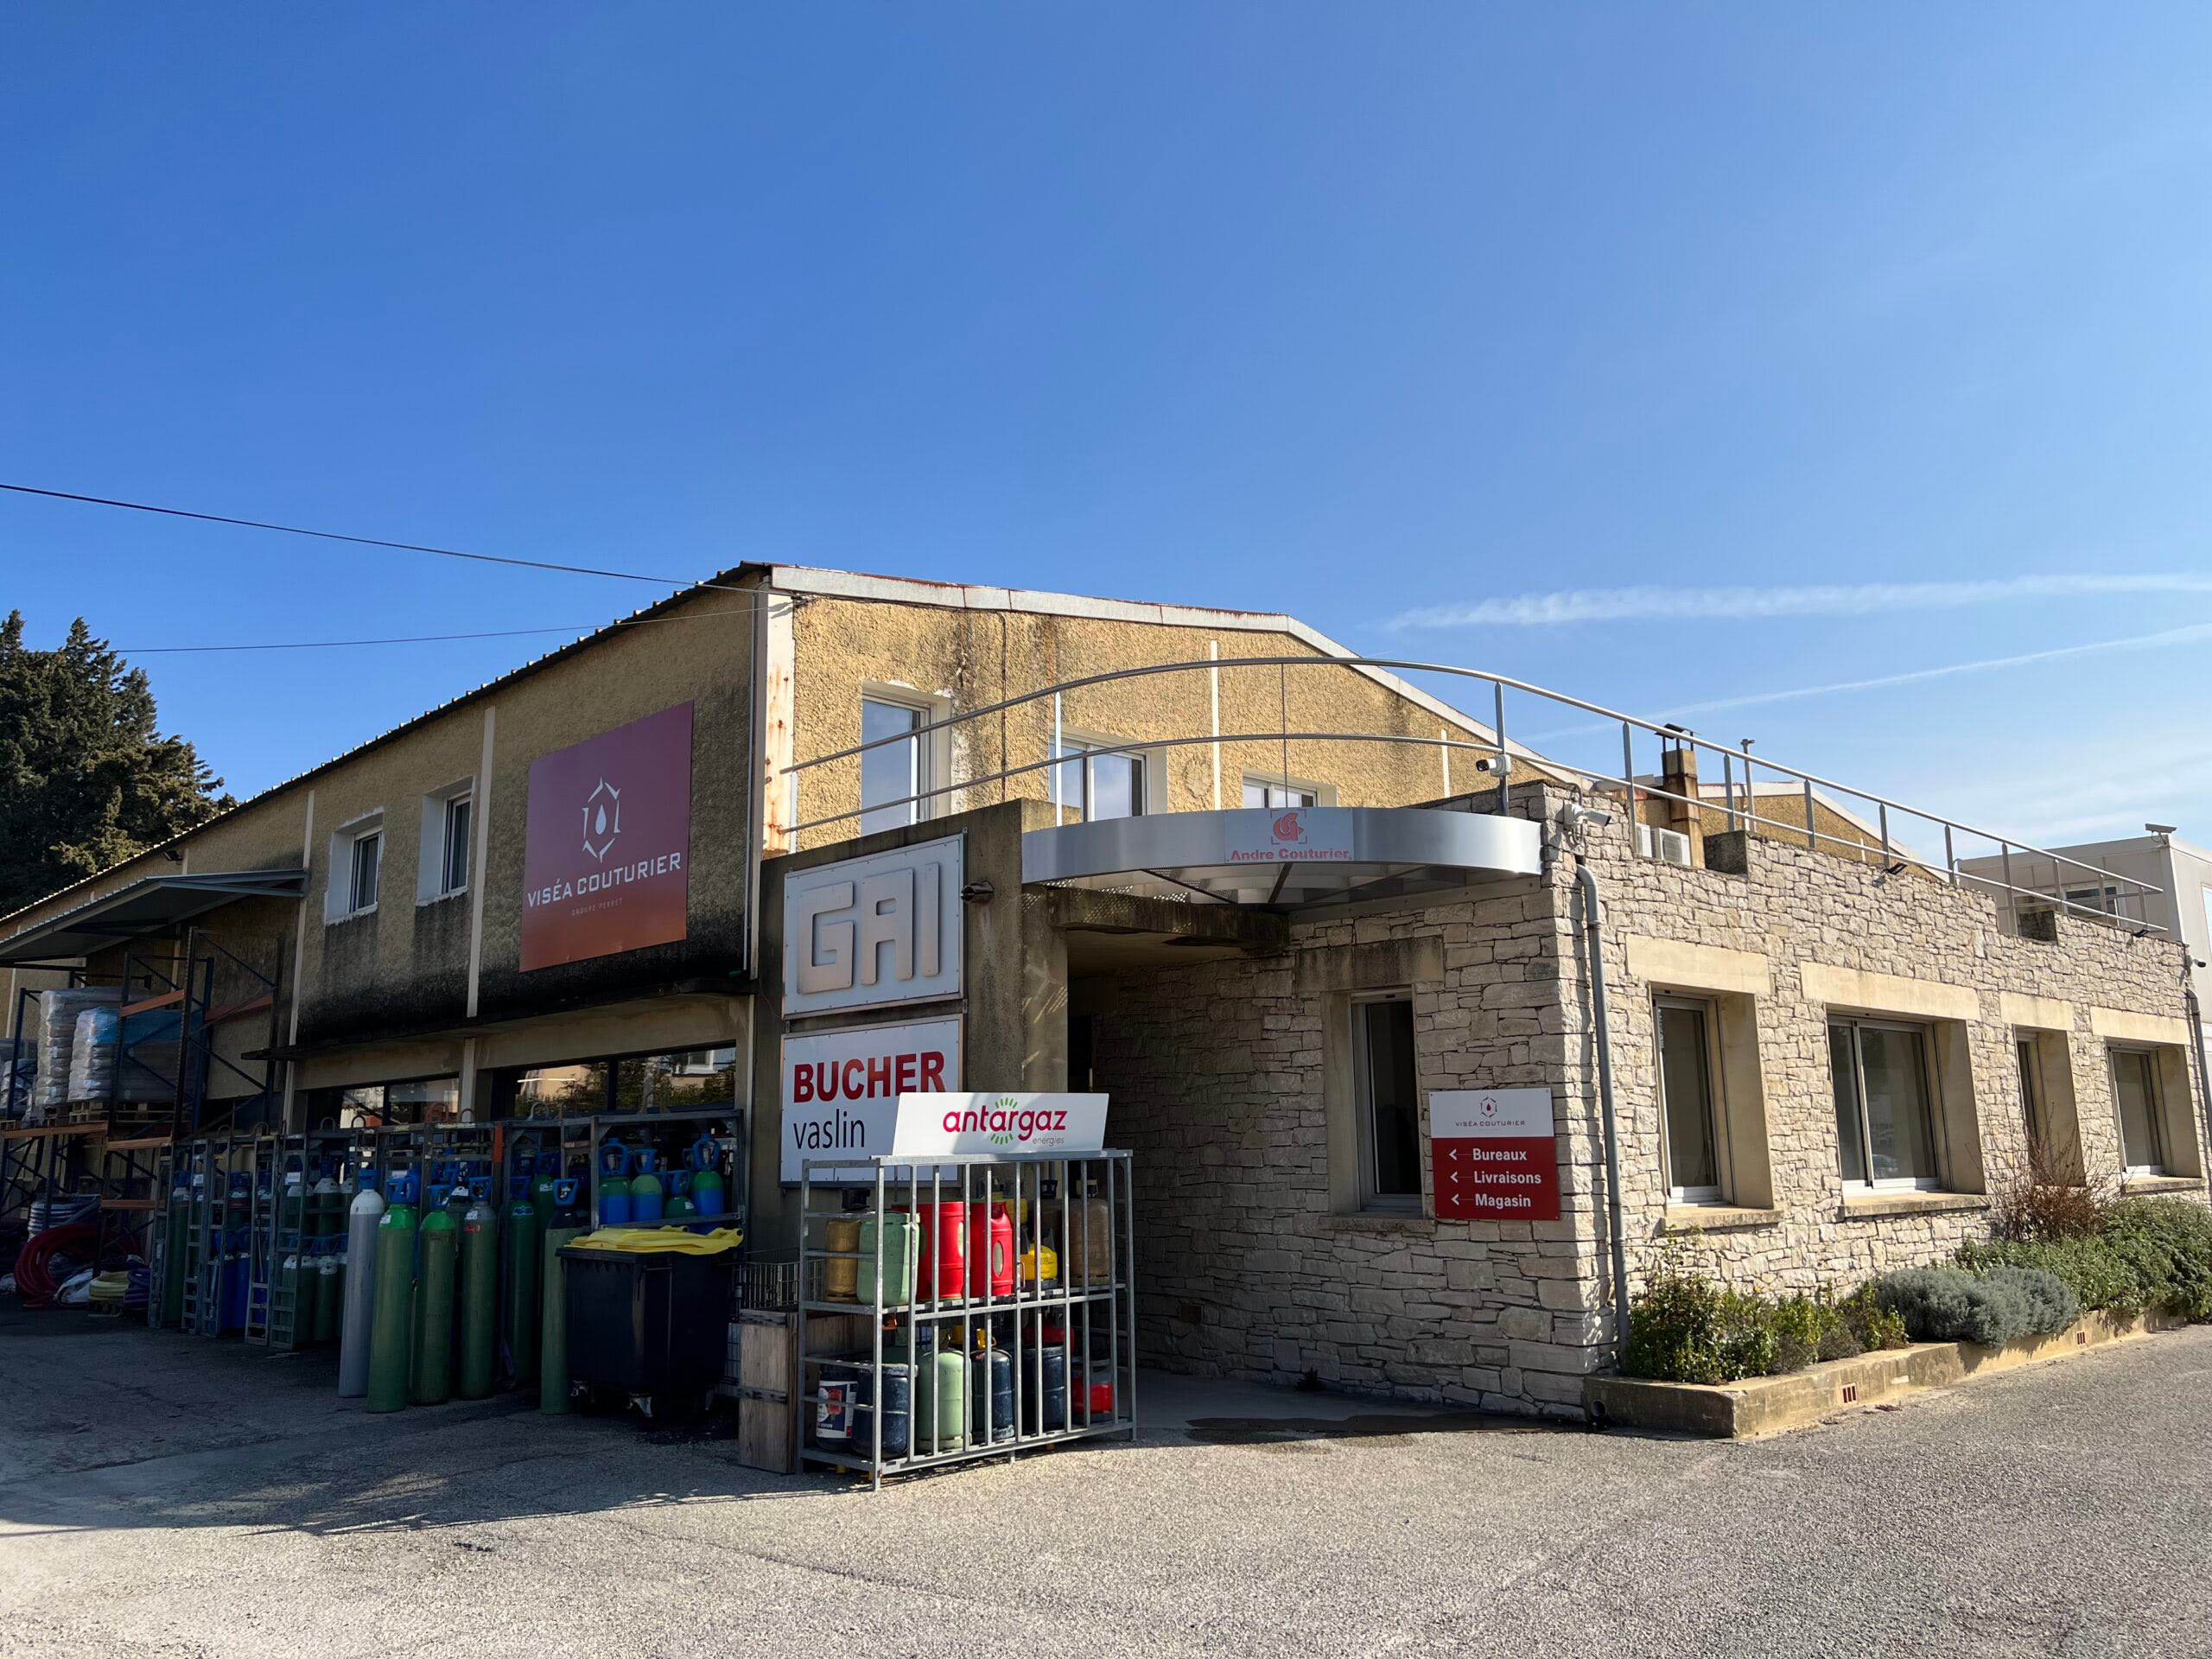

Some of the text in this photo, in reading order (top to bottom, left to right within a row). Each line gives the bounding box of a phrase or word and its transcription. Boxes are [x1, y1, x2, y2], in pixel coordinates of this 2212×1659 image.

[1230, 848, 1349, 861] Andre Couturier
[527, 852, 681, 908] VISÉA COUTURIER
[797, 862, 940, 995] GAI
[793, 1051, 946, 1103] BUCHER
[793, 1109, 865, 1150] vaslin
[943, 1105, 1068, 1141] antargaz
[1033, 1135, 1065, 1147] energies
[1472, 1147, 1528, 1161] Bureaux
[1474, 1171, 1541, 1184] Livraisons
[1475, 1193, 1531, 1210] Magasin
